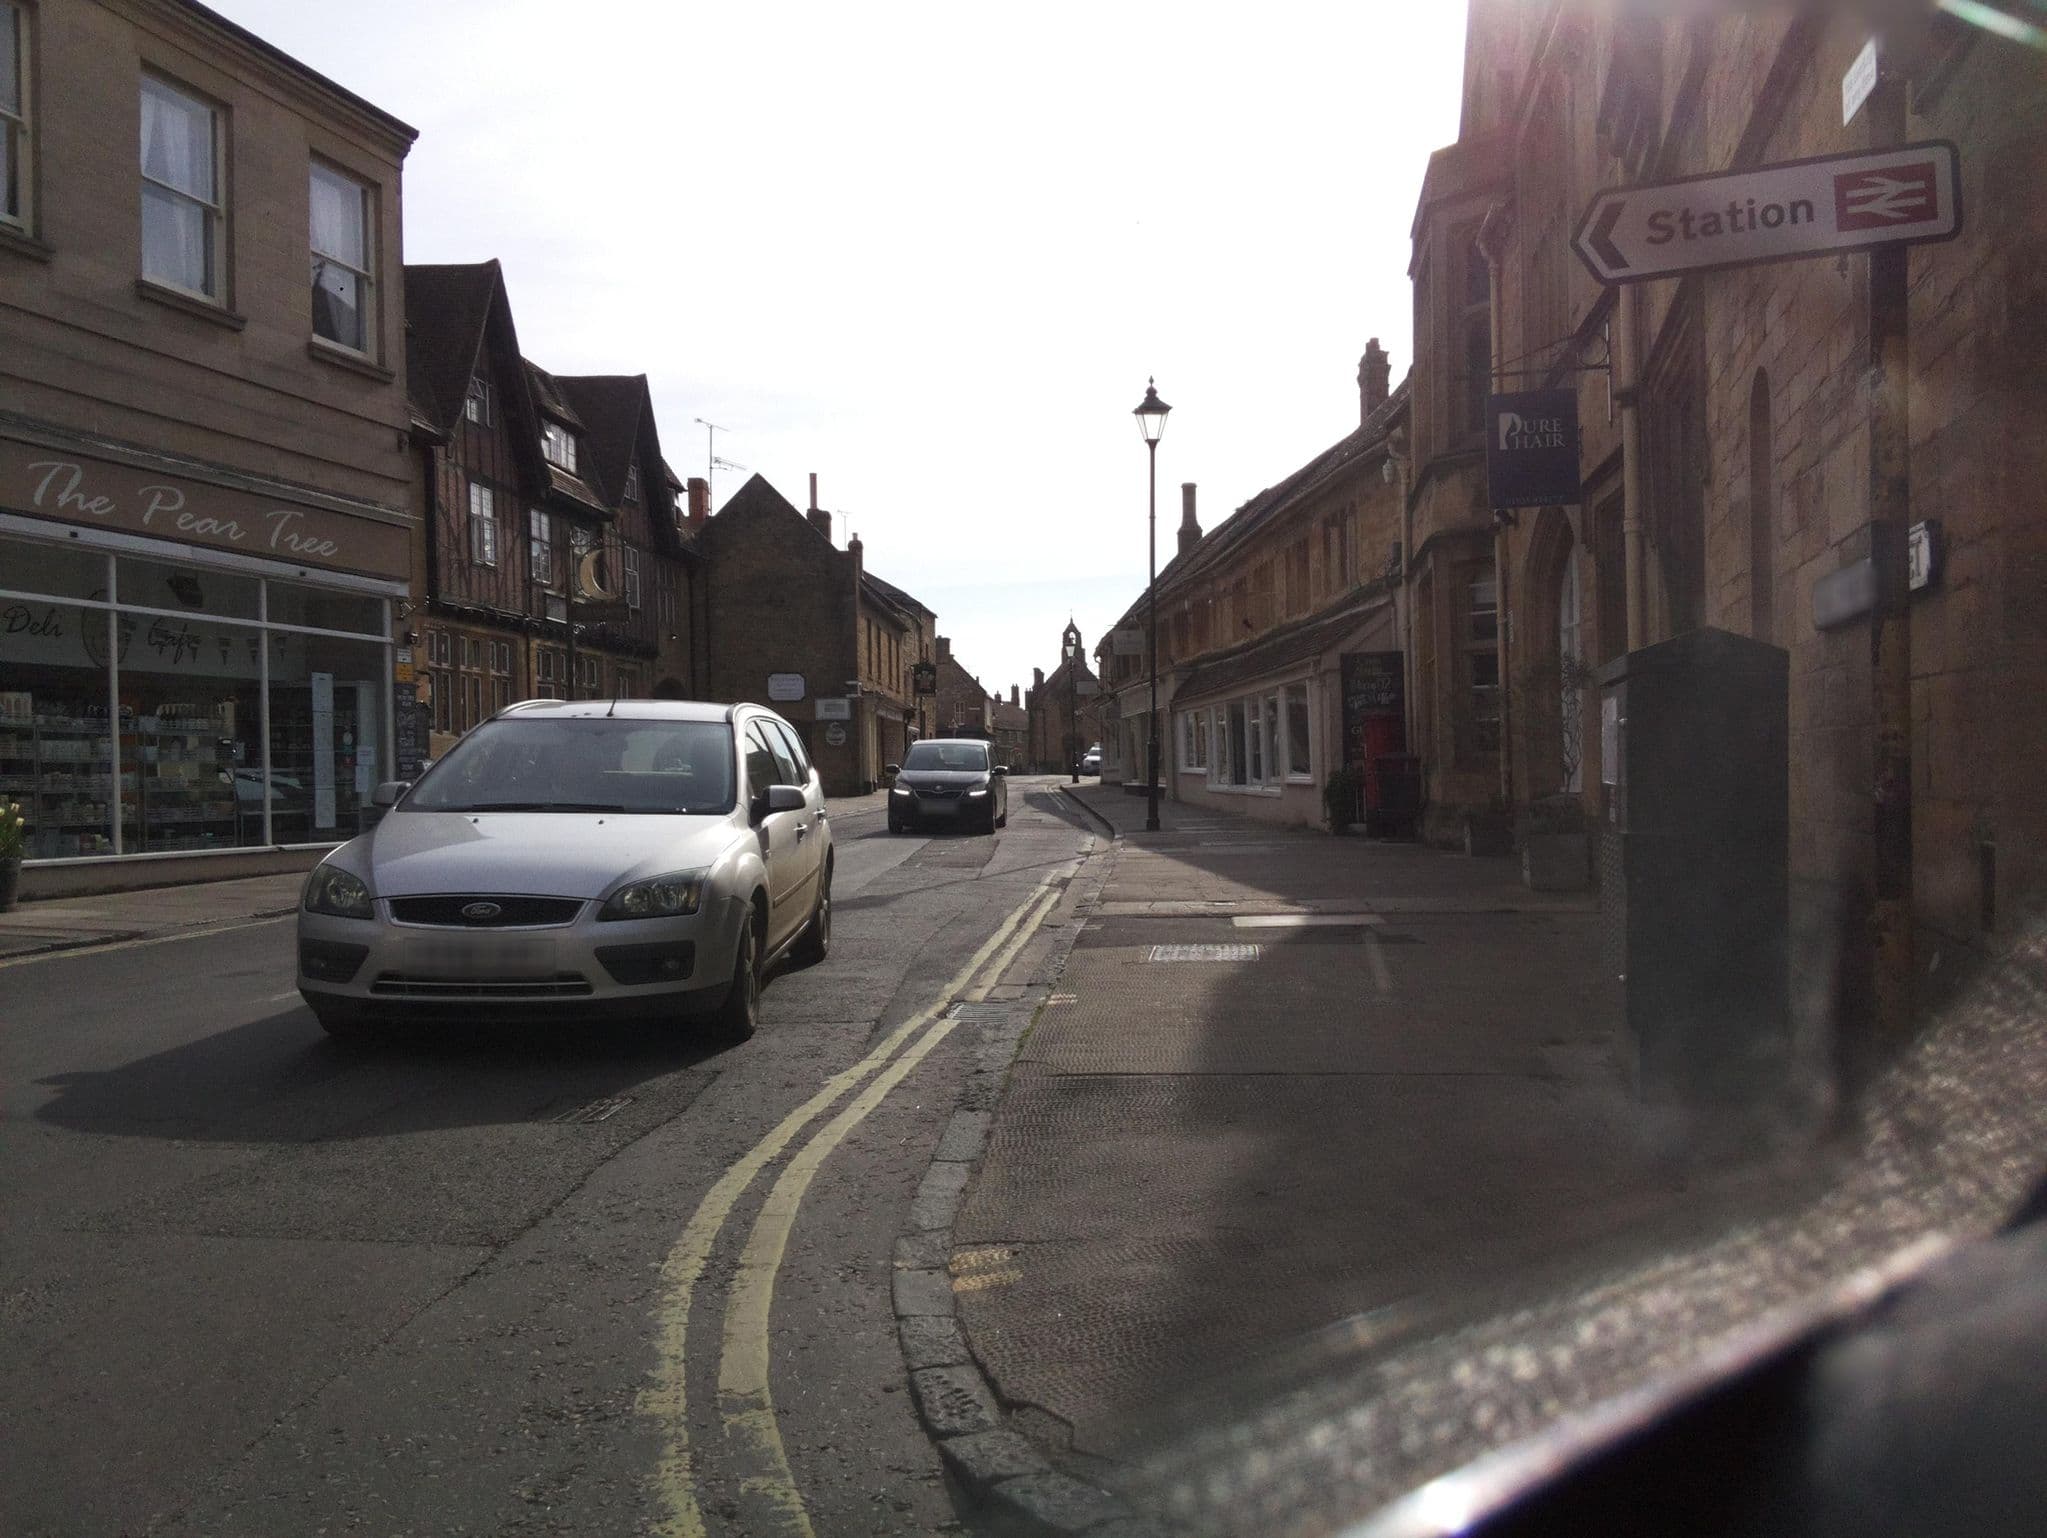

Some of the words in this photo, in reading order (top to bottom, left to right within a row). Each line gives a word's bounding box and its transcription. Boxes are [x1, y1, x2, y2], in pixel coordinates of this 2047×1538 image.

[1646, 198, 1815, 245] Station
[1499, 412, 1562, 450] PURE
[1513, 431, 1566, 449] HAIR
[28, 461, 117, 515] The
[138, 485, 249, 542] Pear
[265, 511, 339, 558] Tree
[3, 605, 63, 637] Deli
